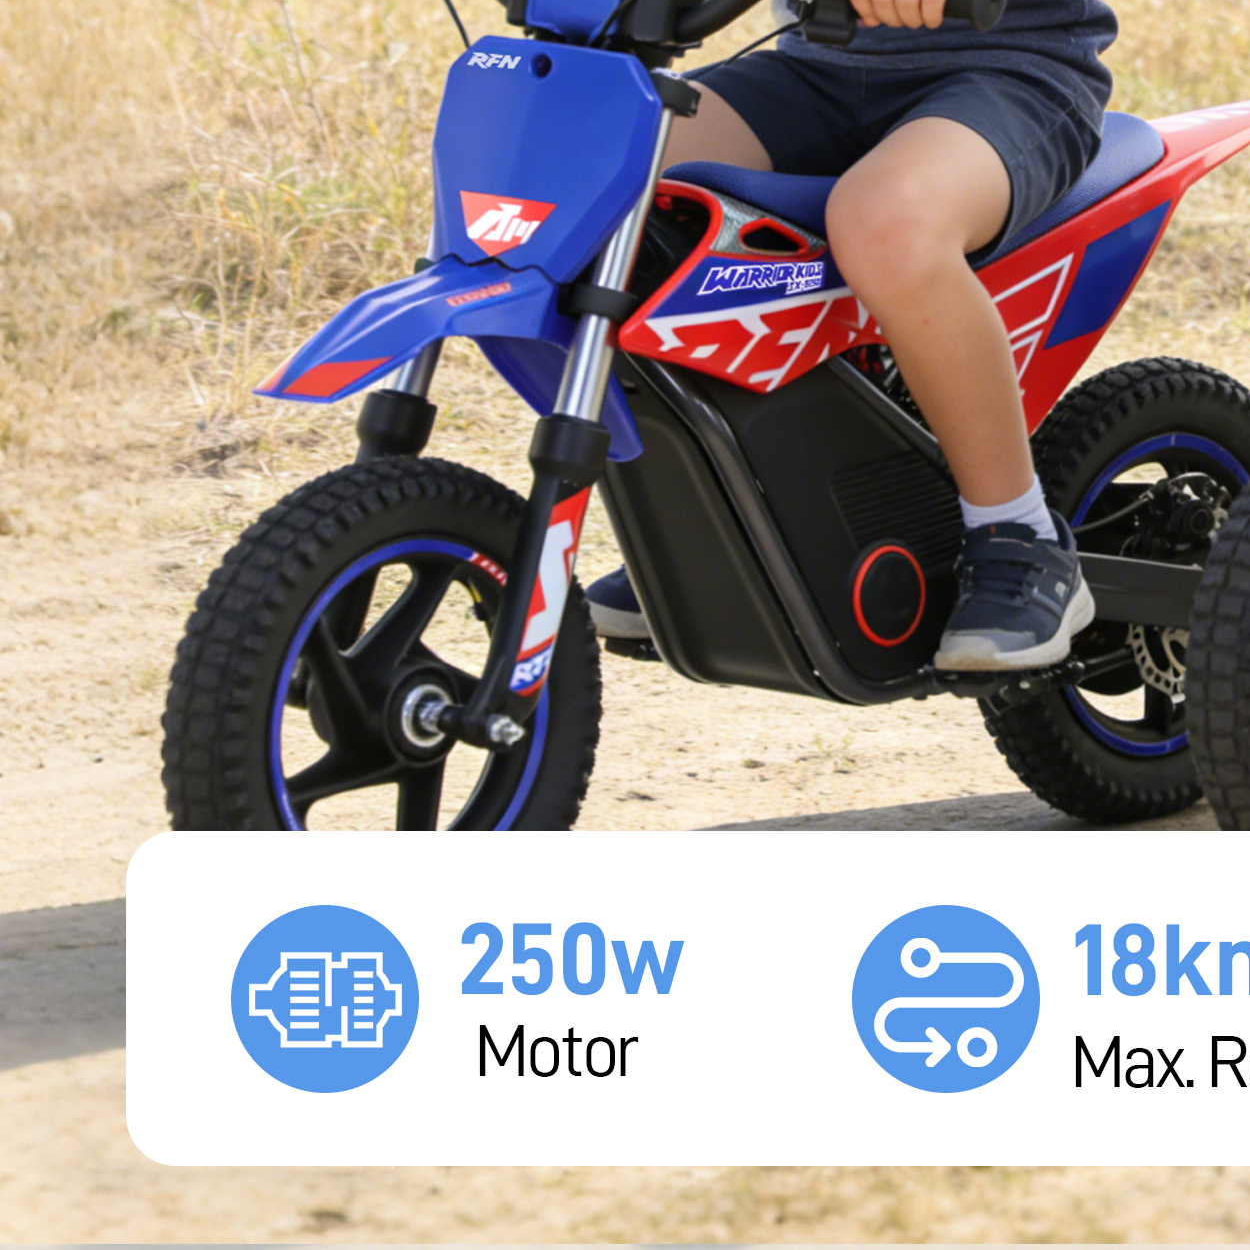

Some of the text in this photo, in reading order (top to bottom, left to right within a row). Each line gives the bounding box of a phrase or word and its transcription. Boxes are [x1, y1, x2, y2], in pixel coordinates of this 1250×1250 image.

[467, 51, 522, 69] RFN
[697, 261, 824, 295] WARRIOR KIDS
